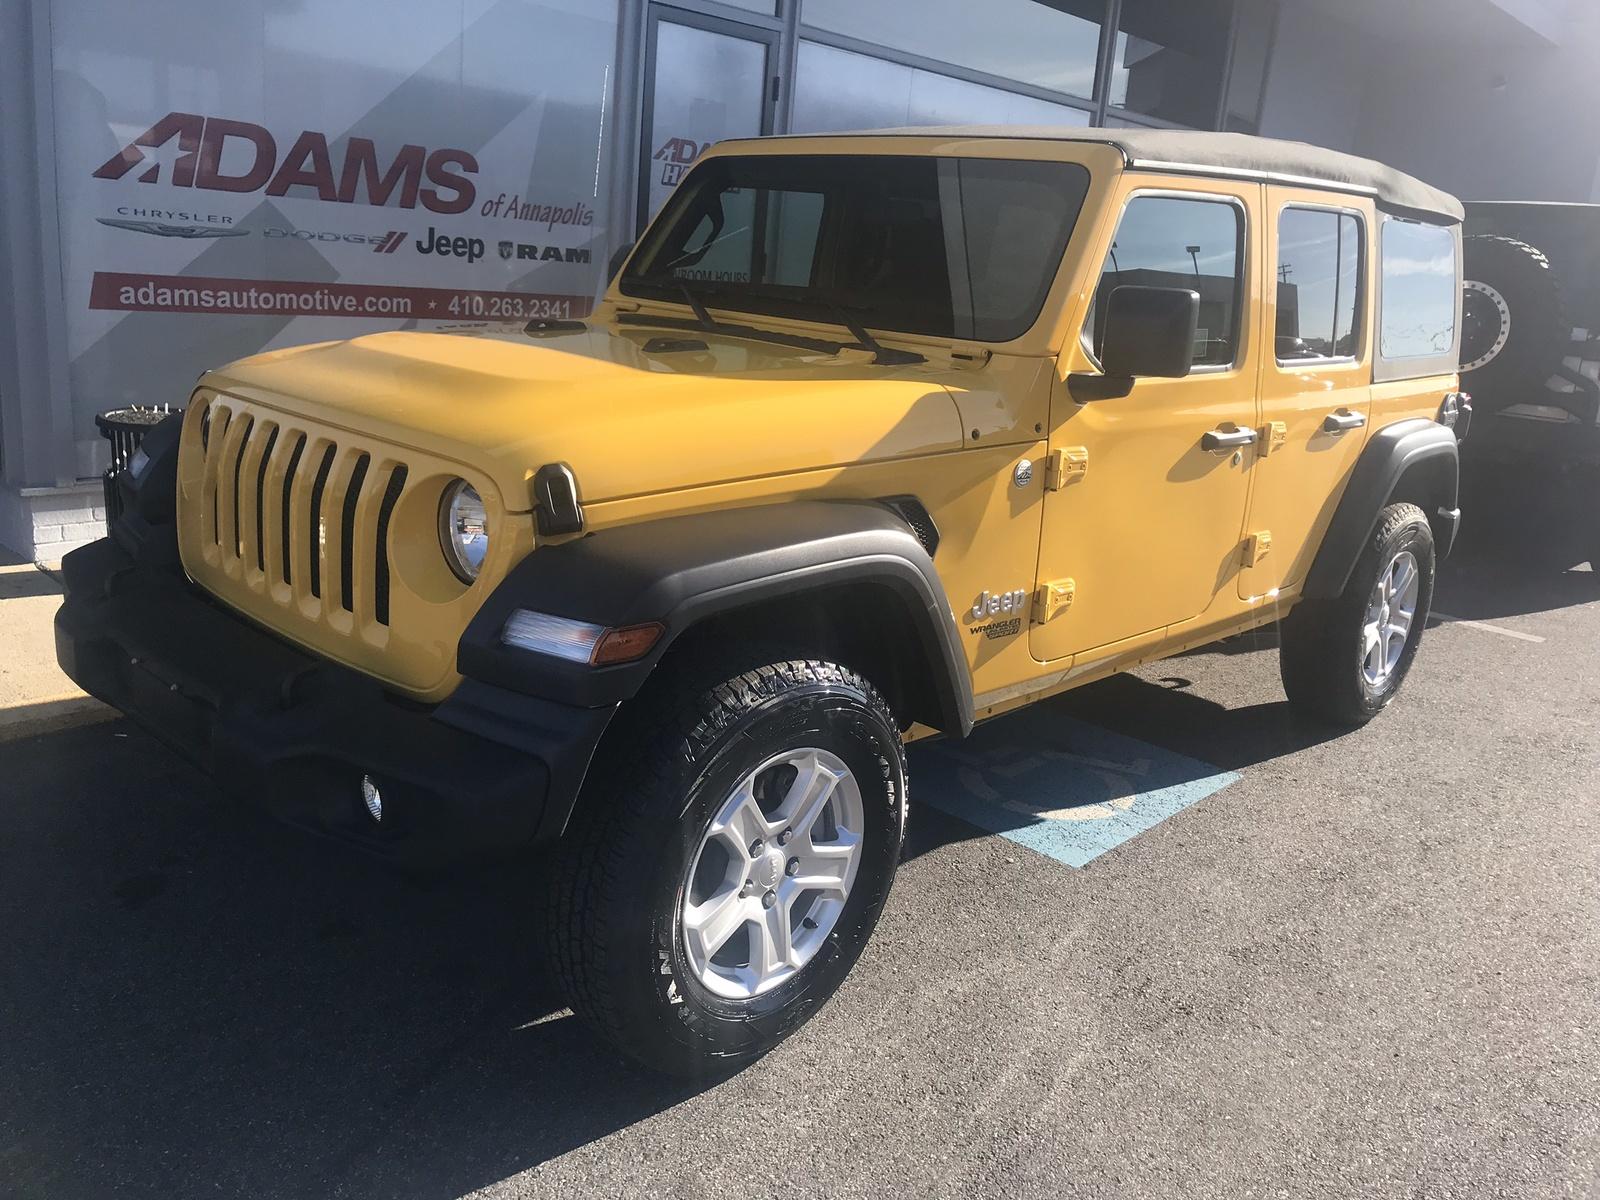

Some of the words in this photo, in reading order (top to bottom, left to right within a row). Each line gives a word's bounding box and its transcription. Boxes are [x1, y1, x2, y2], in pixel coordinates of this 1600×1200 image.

[92, 112, 479, 214] ADAMS
[116, 206, 233, 225] CHRYSLER
[481, 193, 506, 218] of
[504, 195, 594, 232] Annapolis
[263, 227, 388, 245] DODGE
[415, 227, 485, 263] Jeep
[516, 244, 592, 264] RAM
[119, 282, 412, 313] adamsautomotive.com
[448, 295, 571, 319] 410.263.2341
[971, 589, 1025, 619] Jeep
[970, 617, 1021, 635] WRANGLER
